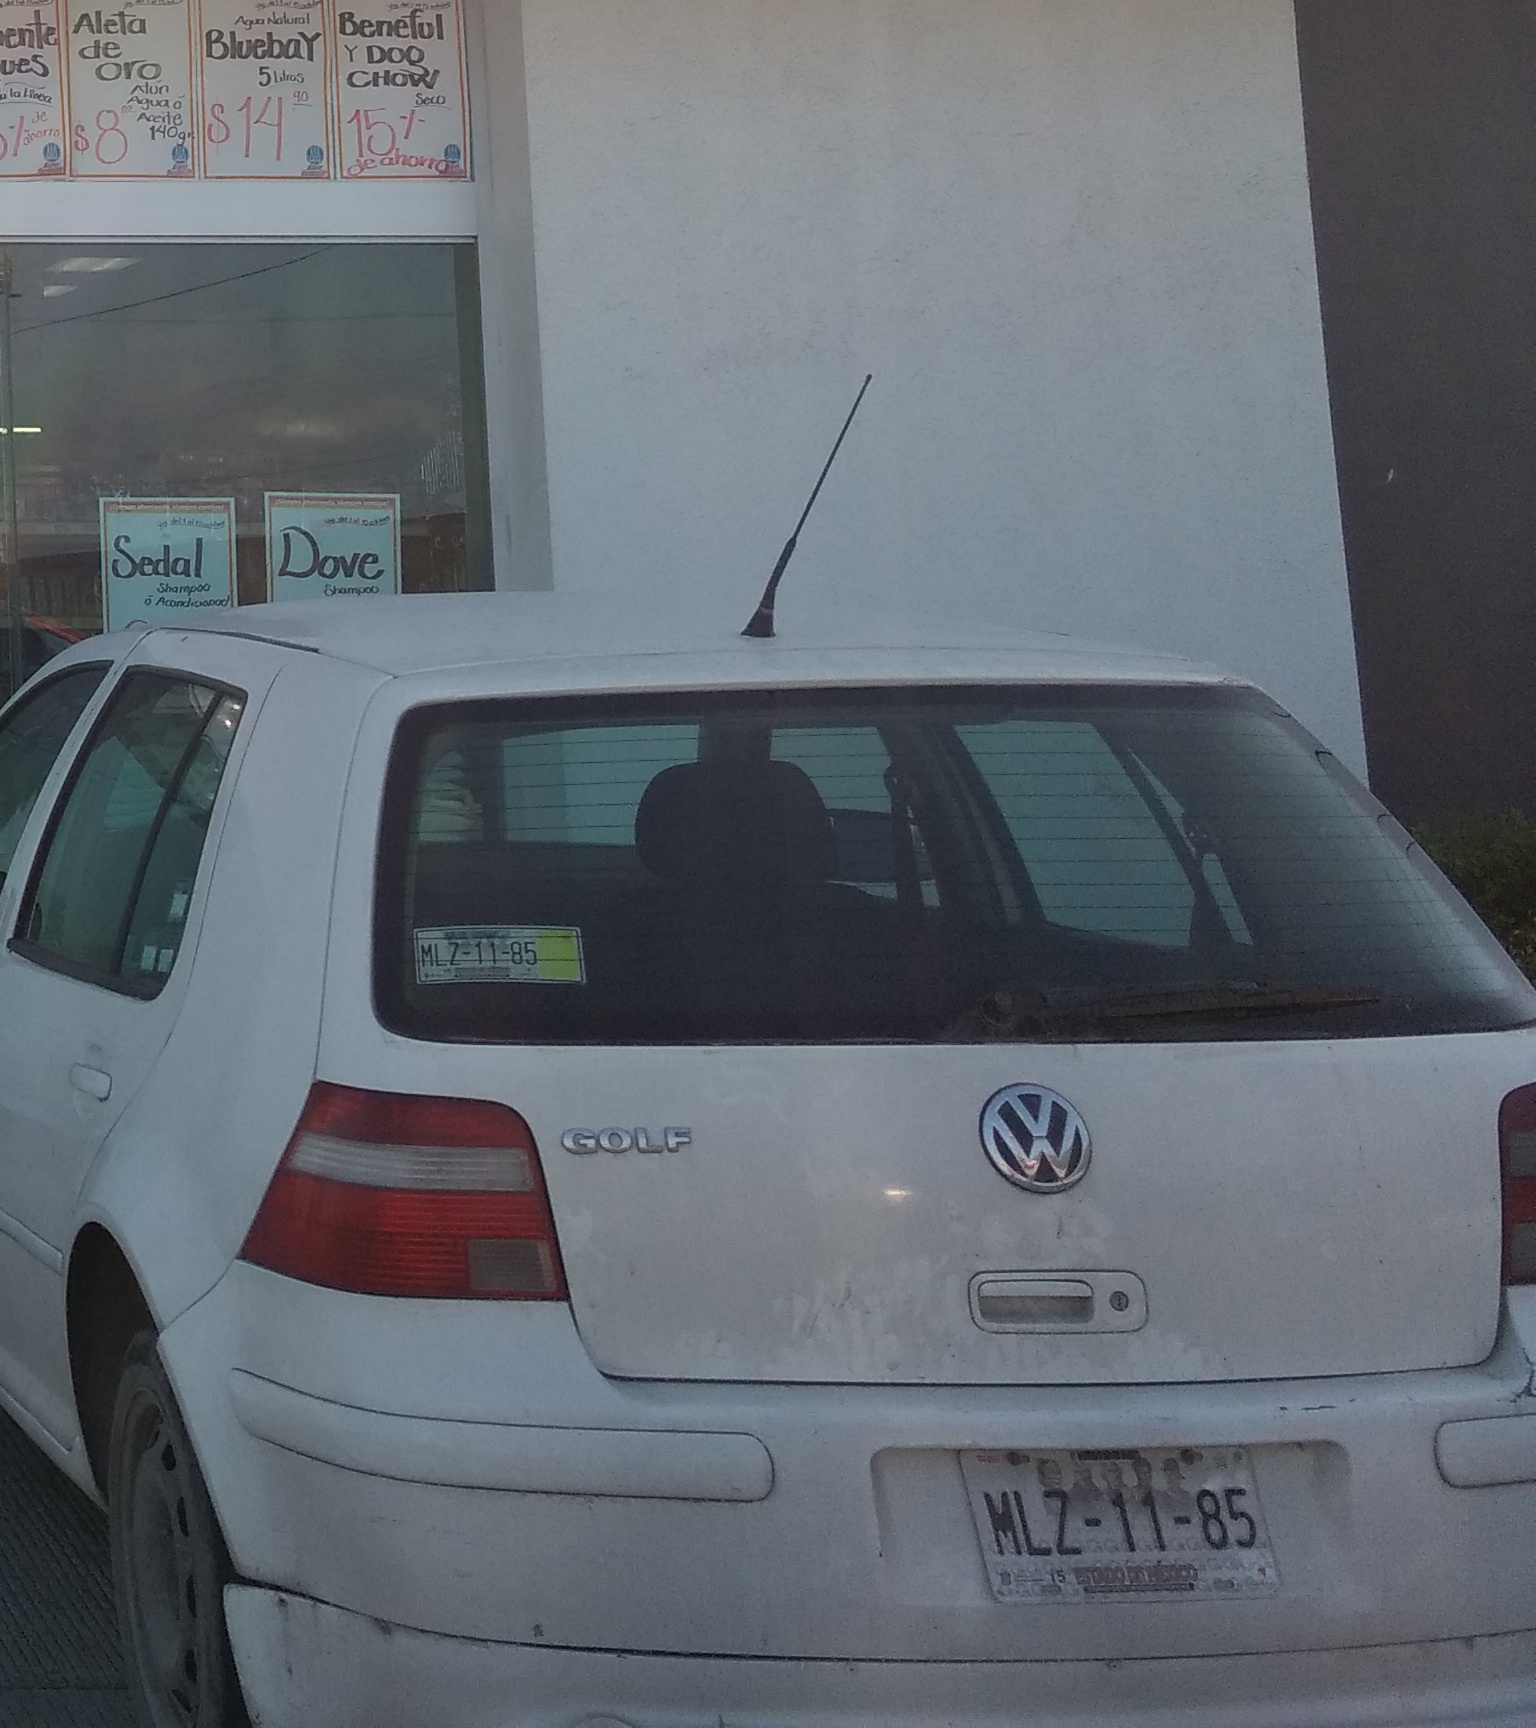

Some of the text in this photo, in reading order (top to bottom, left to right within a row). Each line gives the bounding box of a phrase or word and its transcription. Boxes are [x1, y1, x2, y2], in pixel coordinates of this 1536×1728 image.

[112, 534, 203, 579] Sedal
[278, 525, 385, 580] Dove
[420, 940, 538, 968] MLZ-11-85
[560, 1125, 692, 1155] GOLF
[983, 1487, 1258, 1557] MLZ-11-85
